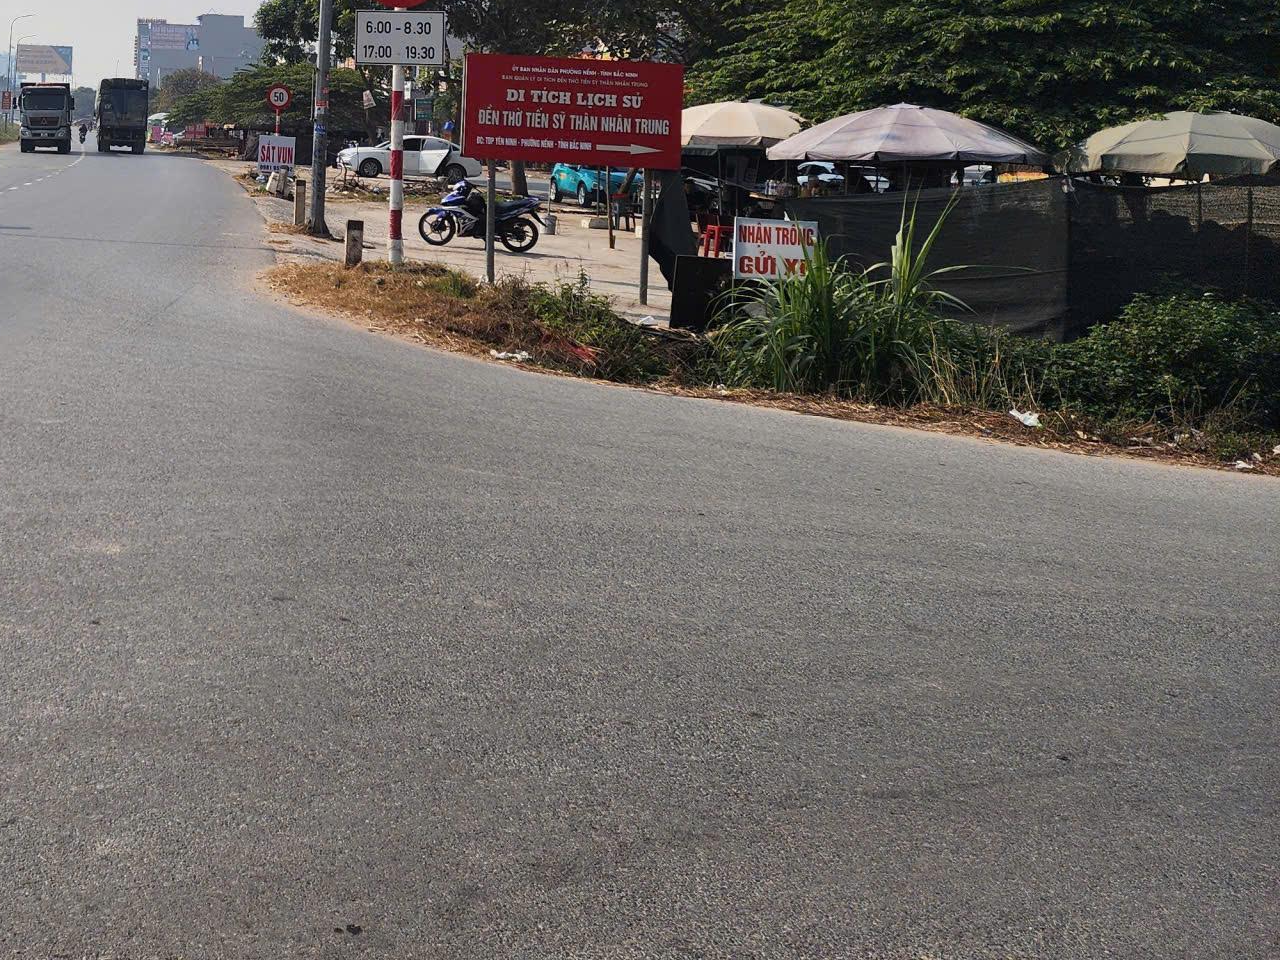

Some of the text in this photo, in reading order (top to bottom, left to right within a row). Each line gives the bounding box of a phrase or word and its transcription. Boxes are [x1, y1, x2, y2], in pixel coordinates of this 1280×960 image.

[366, 21, 392, 34] 6:00
[403, 22, 432, 35] 8.30
[363, 45, 435, 60] 17:00 19:30
[274, 91, 284, 103] 50
[506, 86, 644, 109] DI TÍCH LỊCH SỬ
[478, 104, 500, 126] ĐỀN
[502, 107, 523, 127] THỜ
[525, 107, 549, 129] TIẾN
[569, 112, 598, 132] THÂN
[601, 114, 632, 133] NHÂN
[635, 118, 670, 135] TRUNG
[738, 222, 815, 248] NHẬN TRÔNG
[739, 250, 777, 276] GỬI
